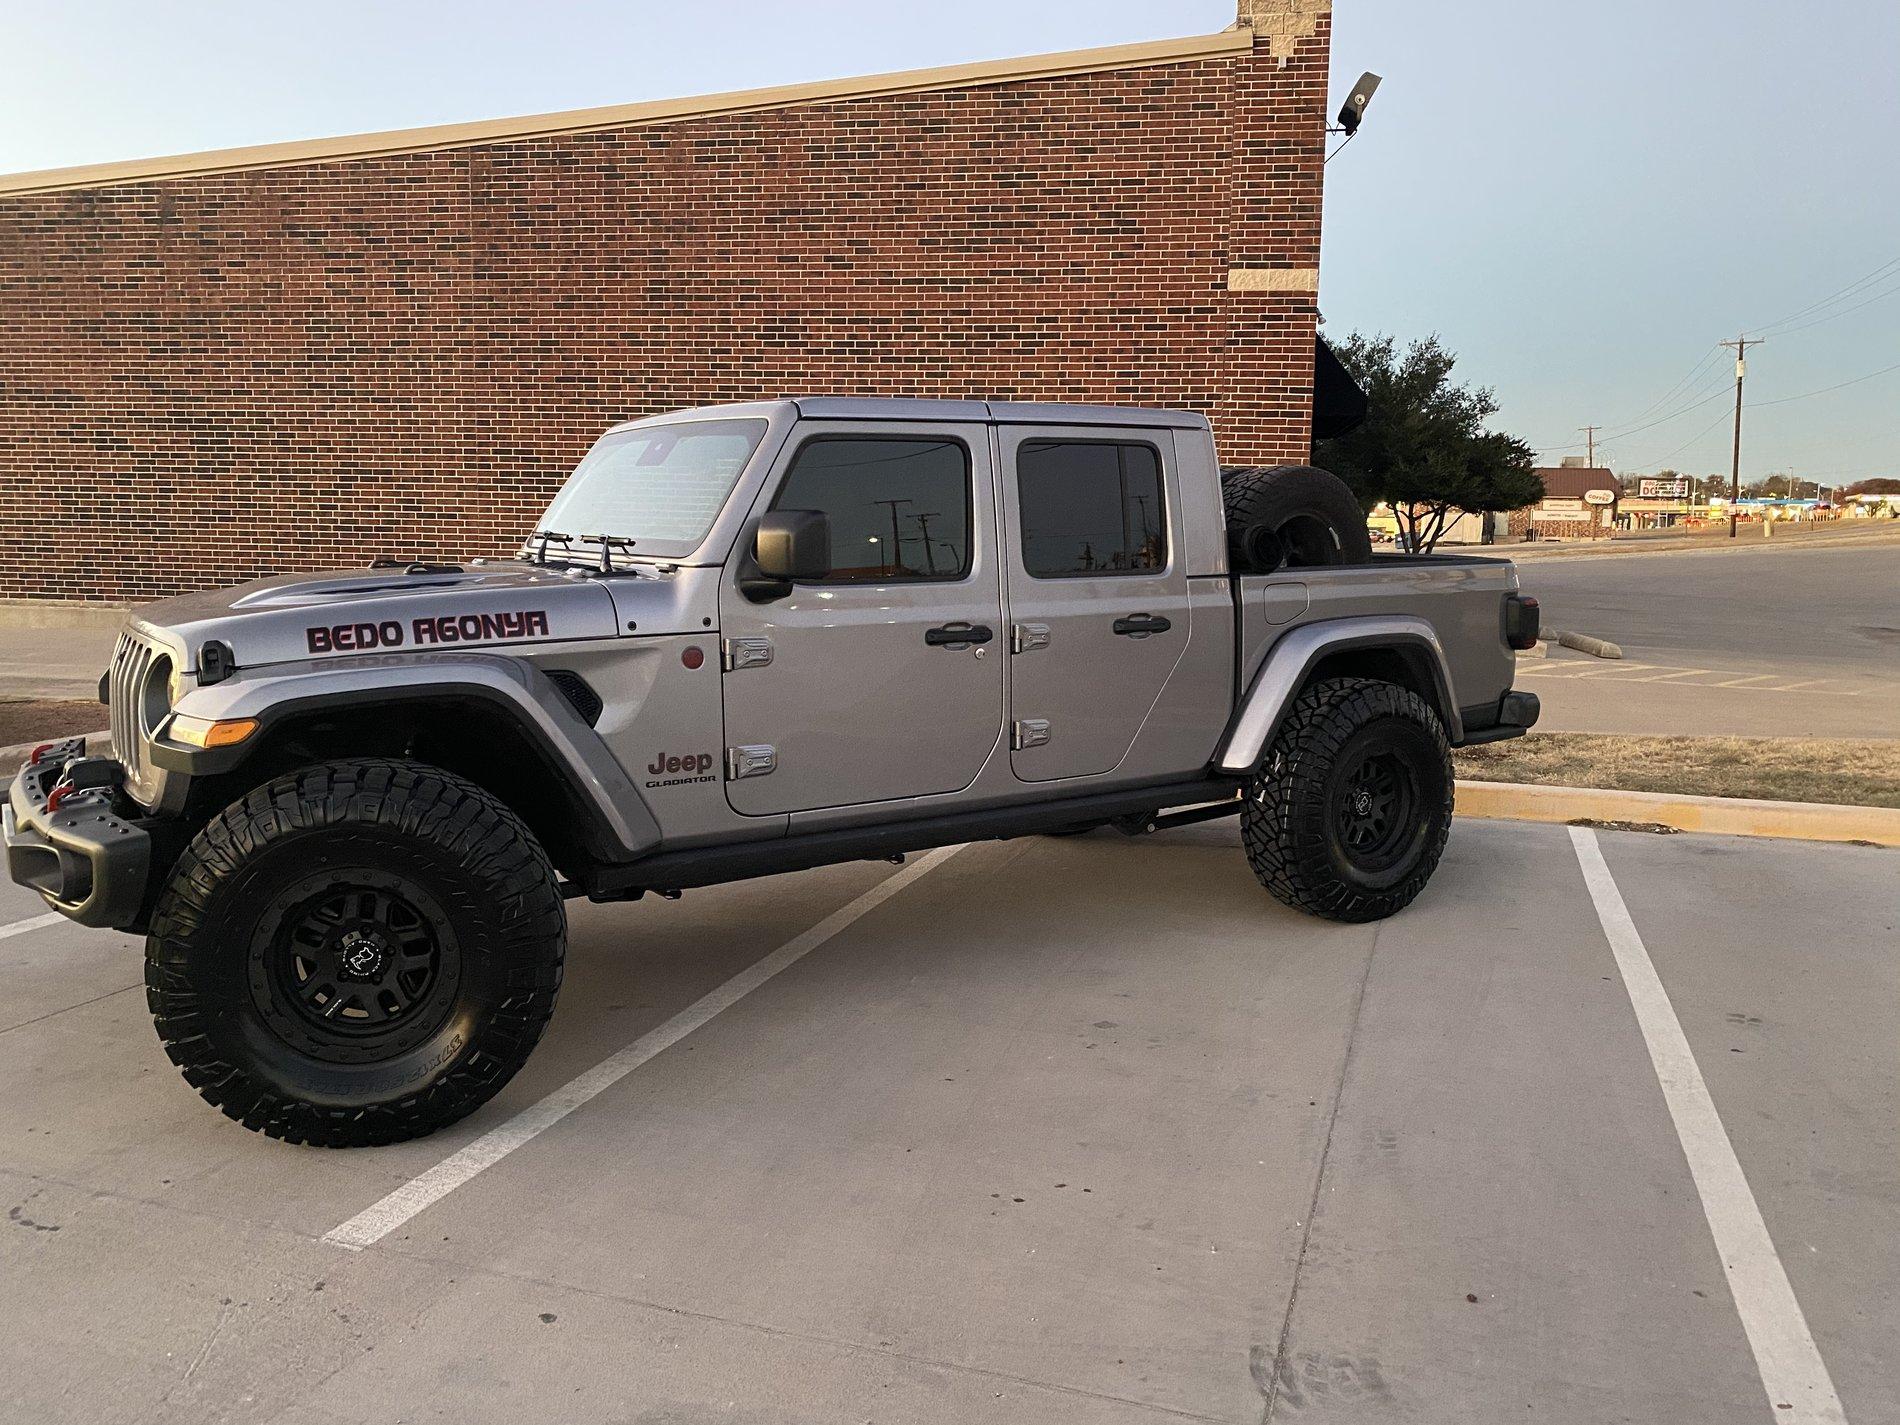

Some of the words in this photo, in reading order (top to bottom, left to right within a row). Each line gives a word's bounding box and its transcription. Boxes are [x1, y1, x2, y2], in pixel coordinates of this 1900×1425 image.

[306, 621, 404, 653] BEDO
[412, 611, 549, 644] AGONYA
[648, 752, 713, 775] Jeep
[645, 775, 717, 788] GLADIATOR
